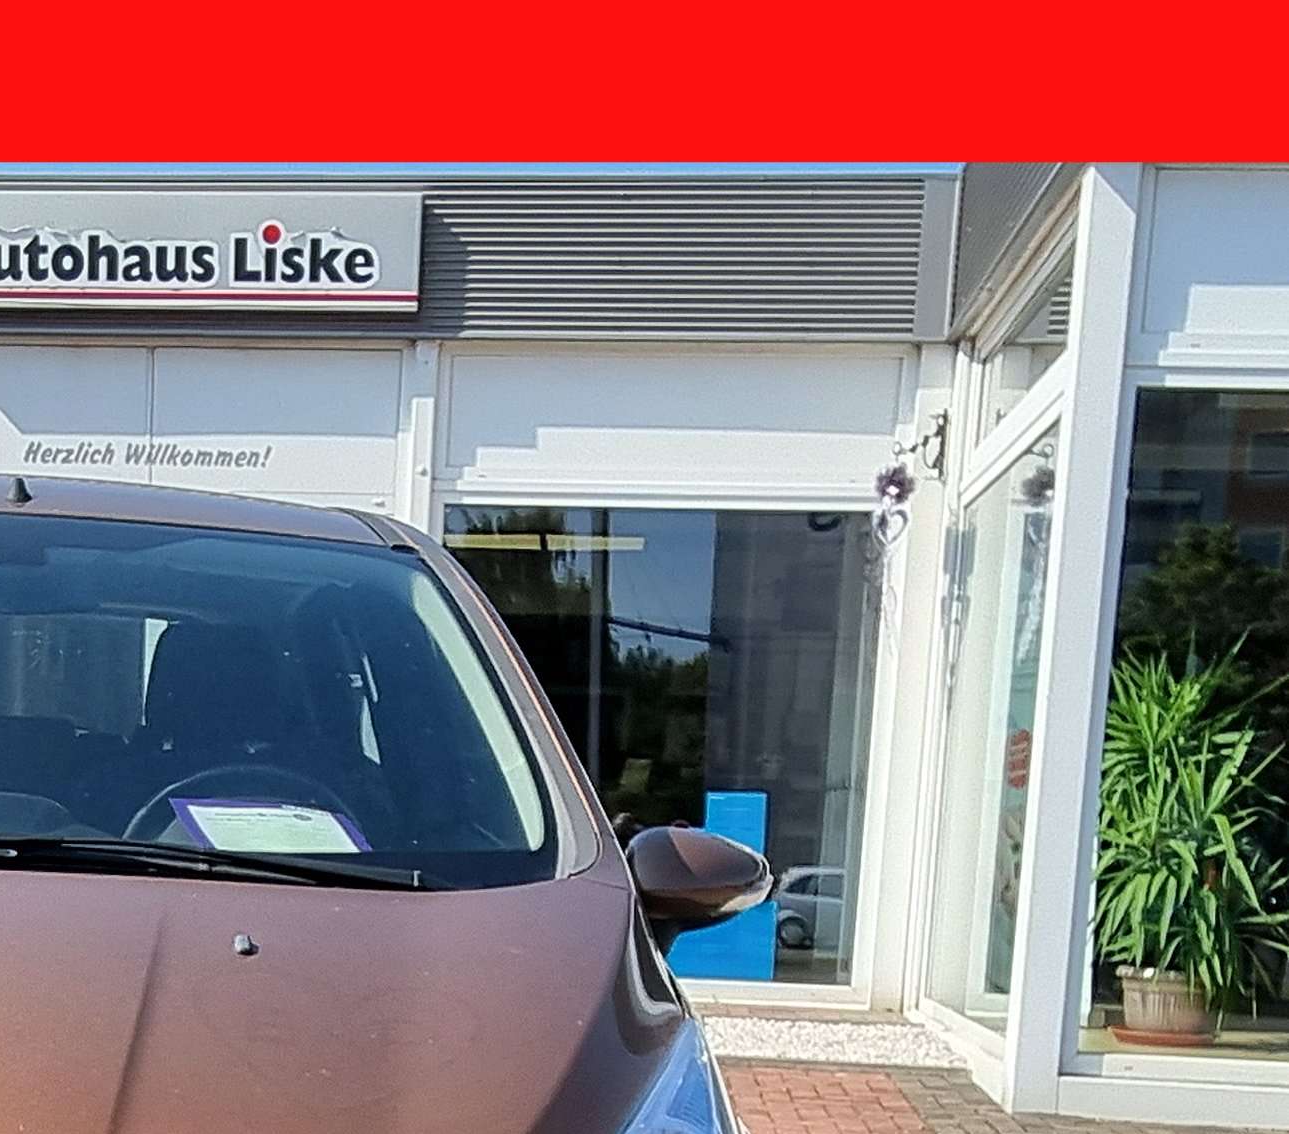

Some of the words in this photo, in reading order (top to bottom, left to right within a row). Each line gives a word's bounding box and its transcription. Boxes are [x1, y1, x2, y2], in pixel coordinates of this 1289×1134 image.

[233, 223, 376, 284] Liske
[23, 441, 115, 465] Herzlich
[124, 442, 272, 469] Willkommen!
